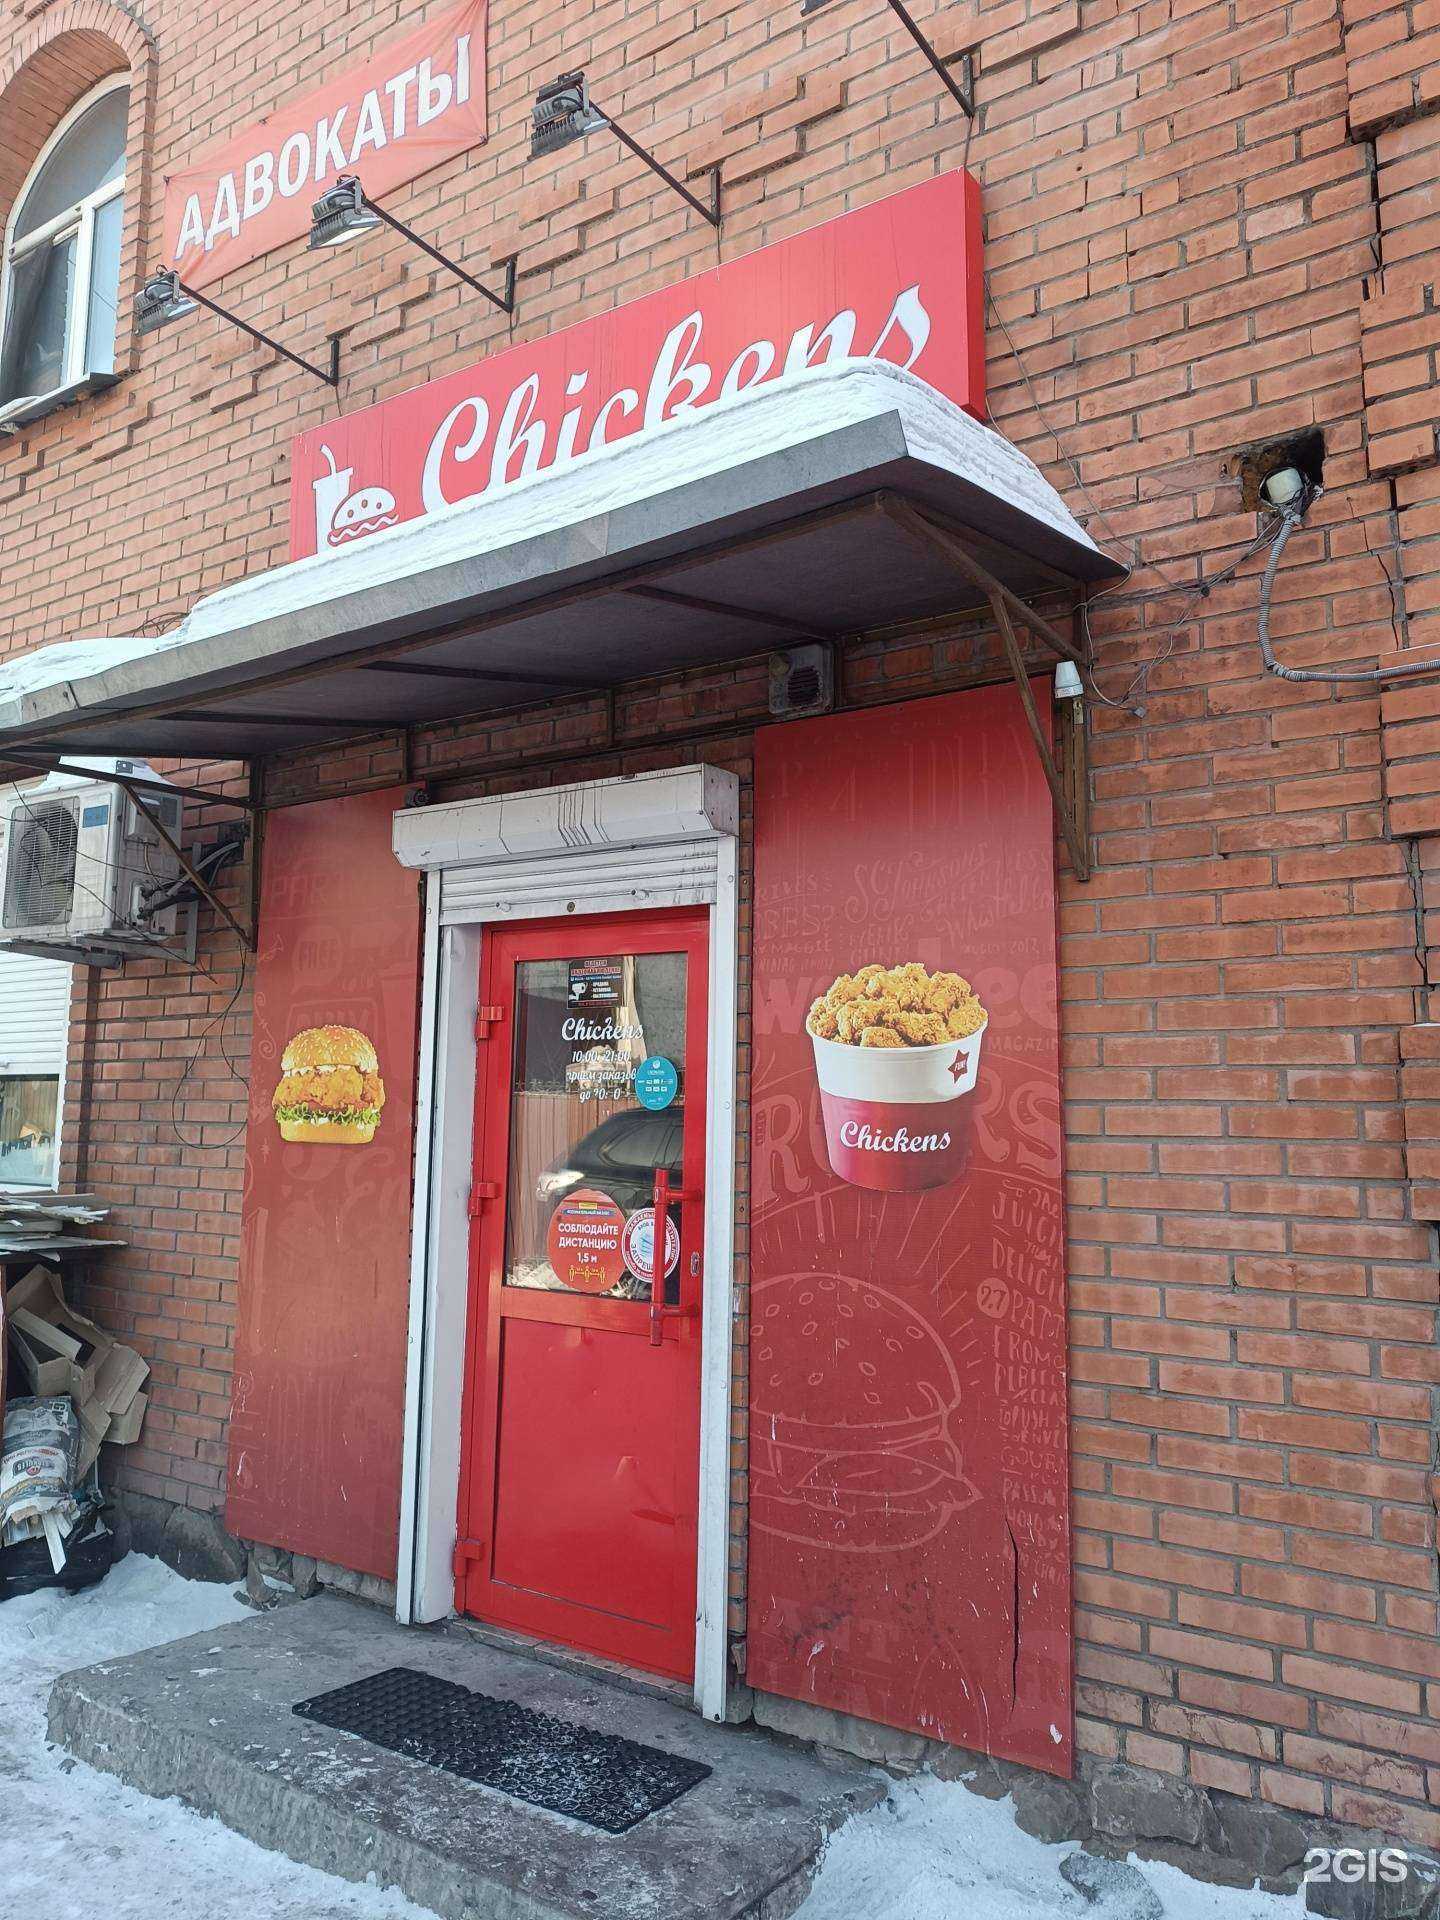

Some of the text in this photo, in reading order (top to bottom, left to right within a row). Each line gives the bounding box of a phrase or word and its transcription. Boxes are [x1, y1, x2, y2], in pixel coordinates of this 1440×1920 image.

[174, 33, 471, 261] АДВОКАТЫ
[420, 284, 931, 515] Chickens
[561, 1016, 643, 1041] Chickens
[840, 1120, 952, 1153] Chickens
[558, 1222, 619, 1235] СОБЛЮДАЙТЕ
[558, 1237, 617, 1250] ДИСТАНЦИЮ
[577, 1252, 590, 1264] 1,5
